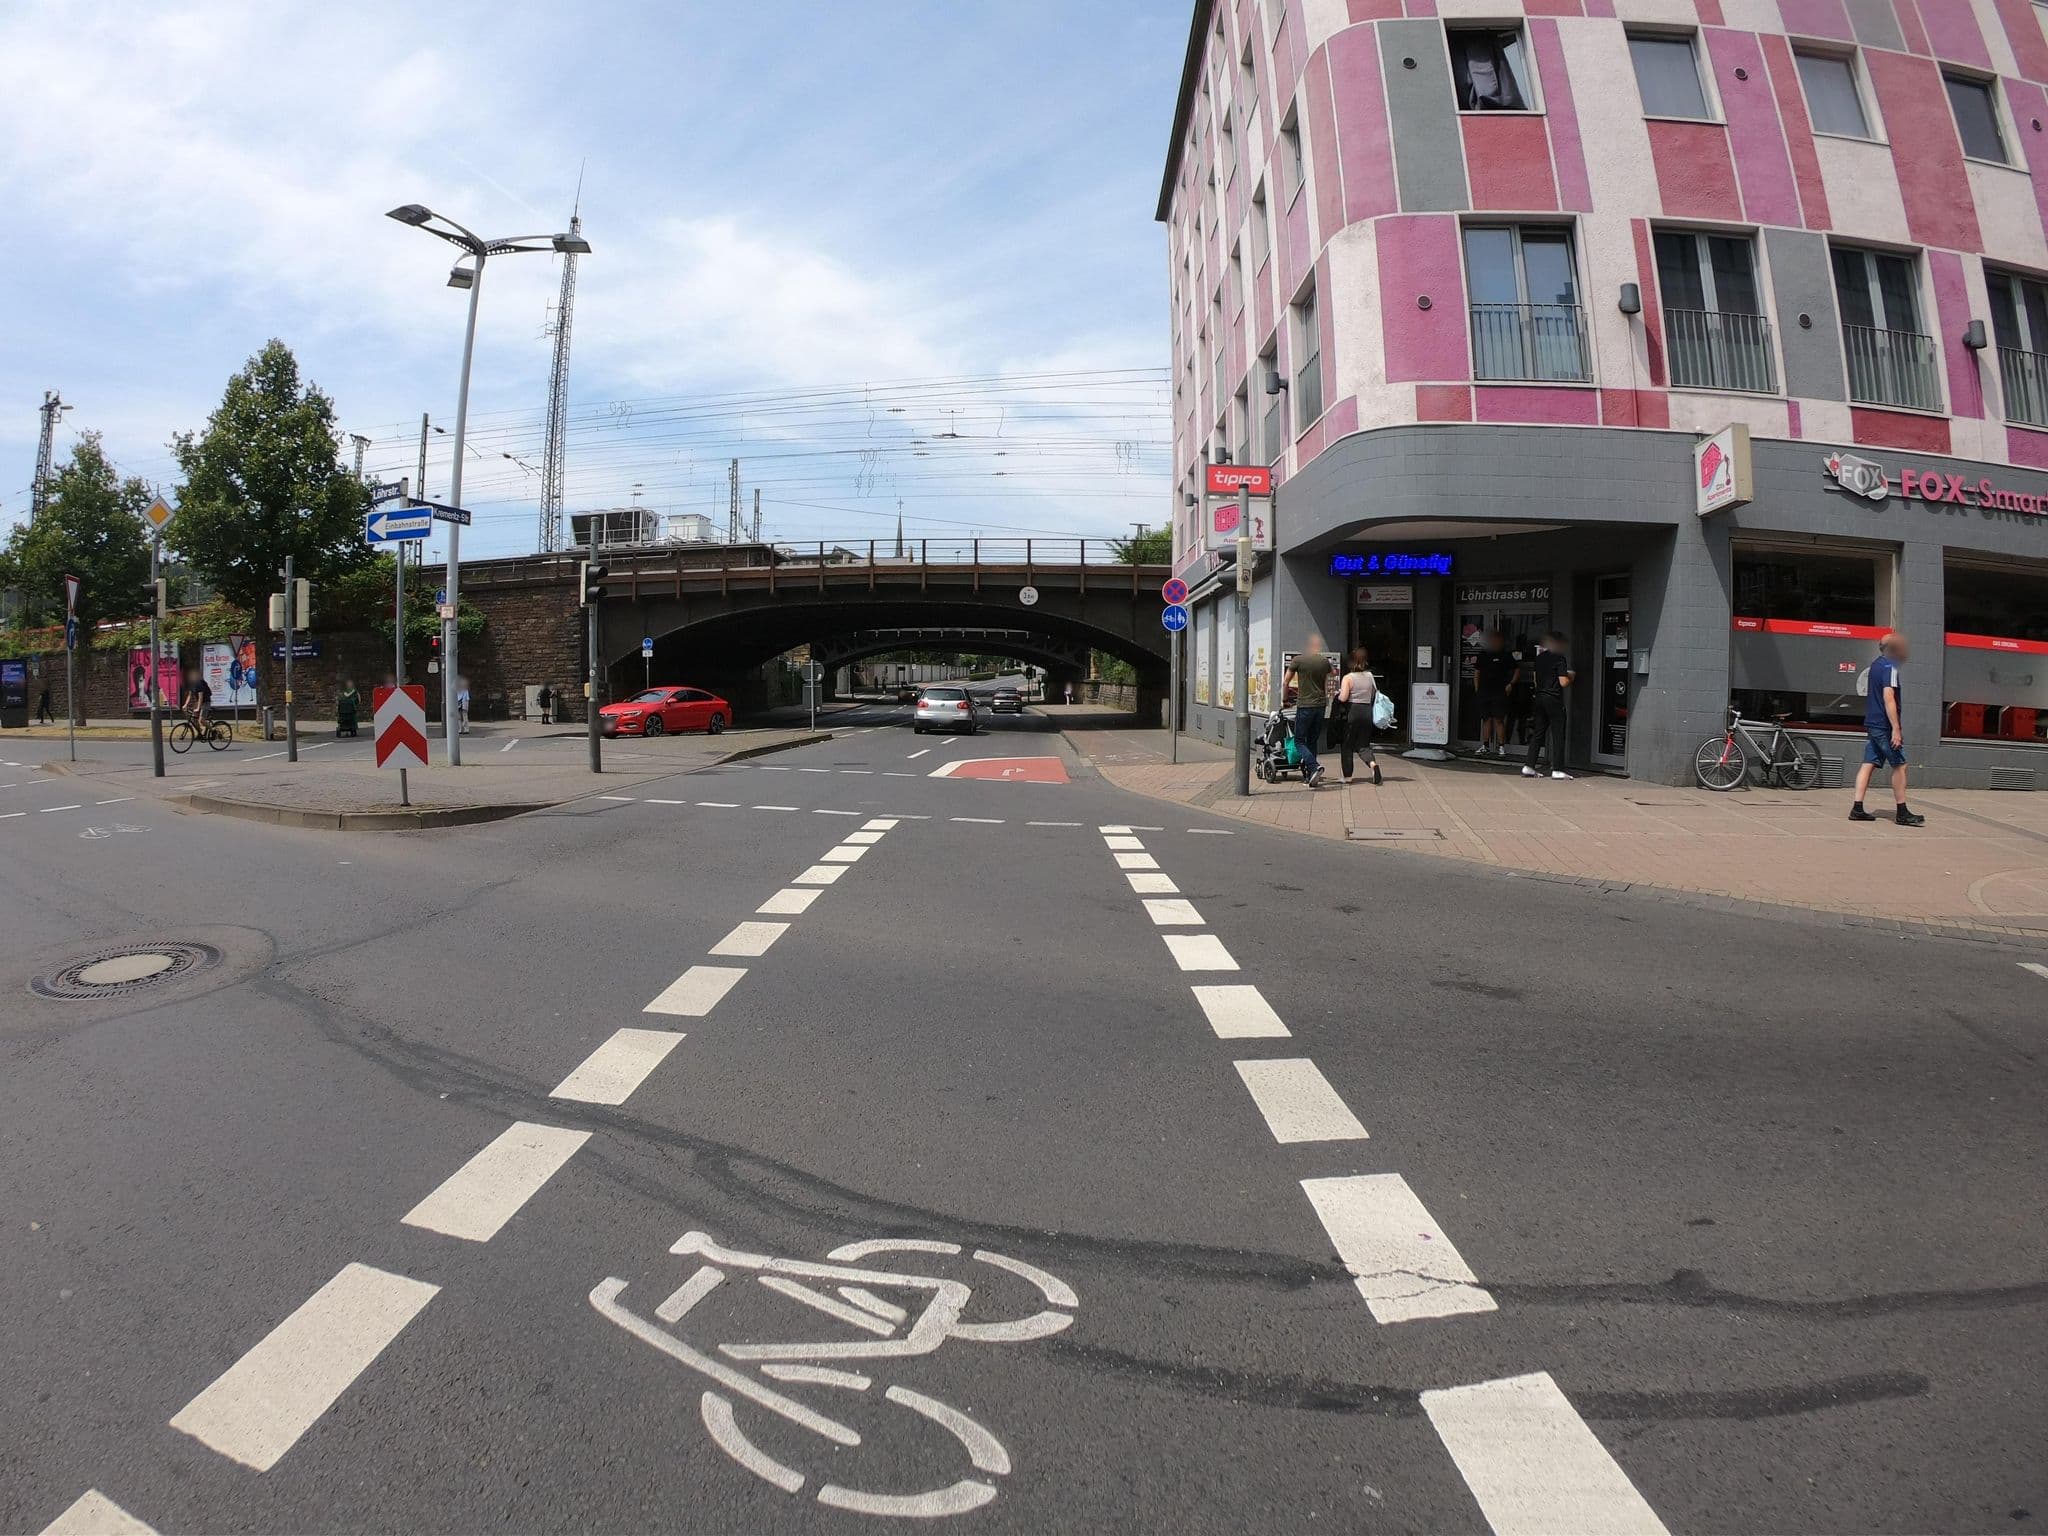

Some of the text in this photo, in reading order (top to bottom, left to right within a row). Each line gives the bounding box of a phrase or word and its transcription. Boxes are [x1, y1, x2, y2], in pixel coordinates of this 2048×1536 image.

[1214, 471, 1262, 486] tipico
[1842, 465, 1881, 489] FOX
[373, 486, 400, 499] Löhrstr.
[1901, 469, 2048, 514] FOX-Smar
[385, 520, 429, 531] Einbahnstraße
[1334, 554, 1452, 572] Gut & Günstig
[1461, 588, 1527, 601] Löhrstrasse
